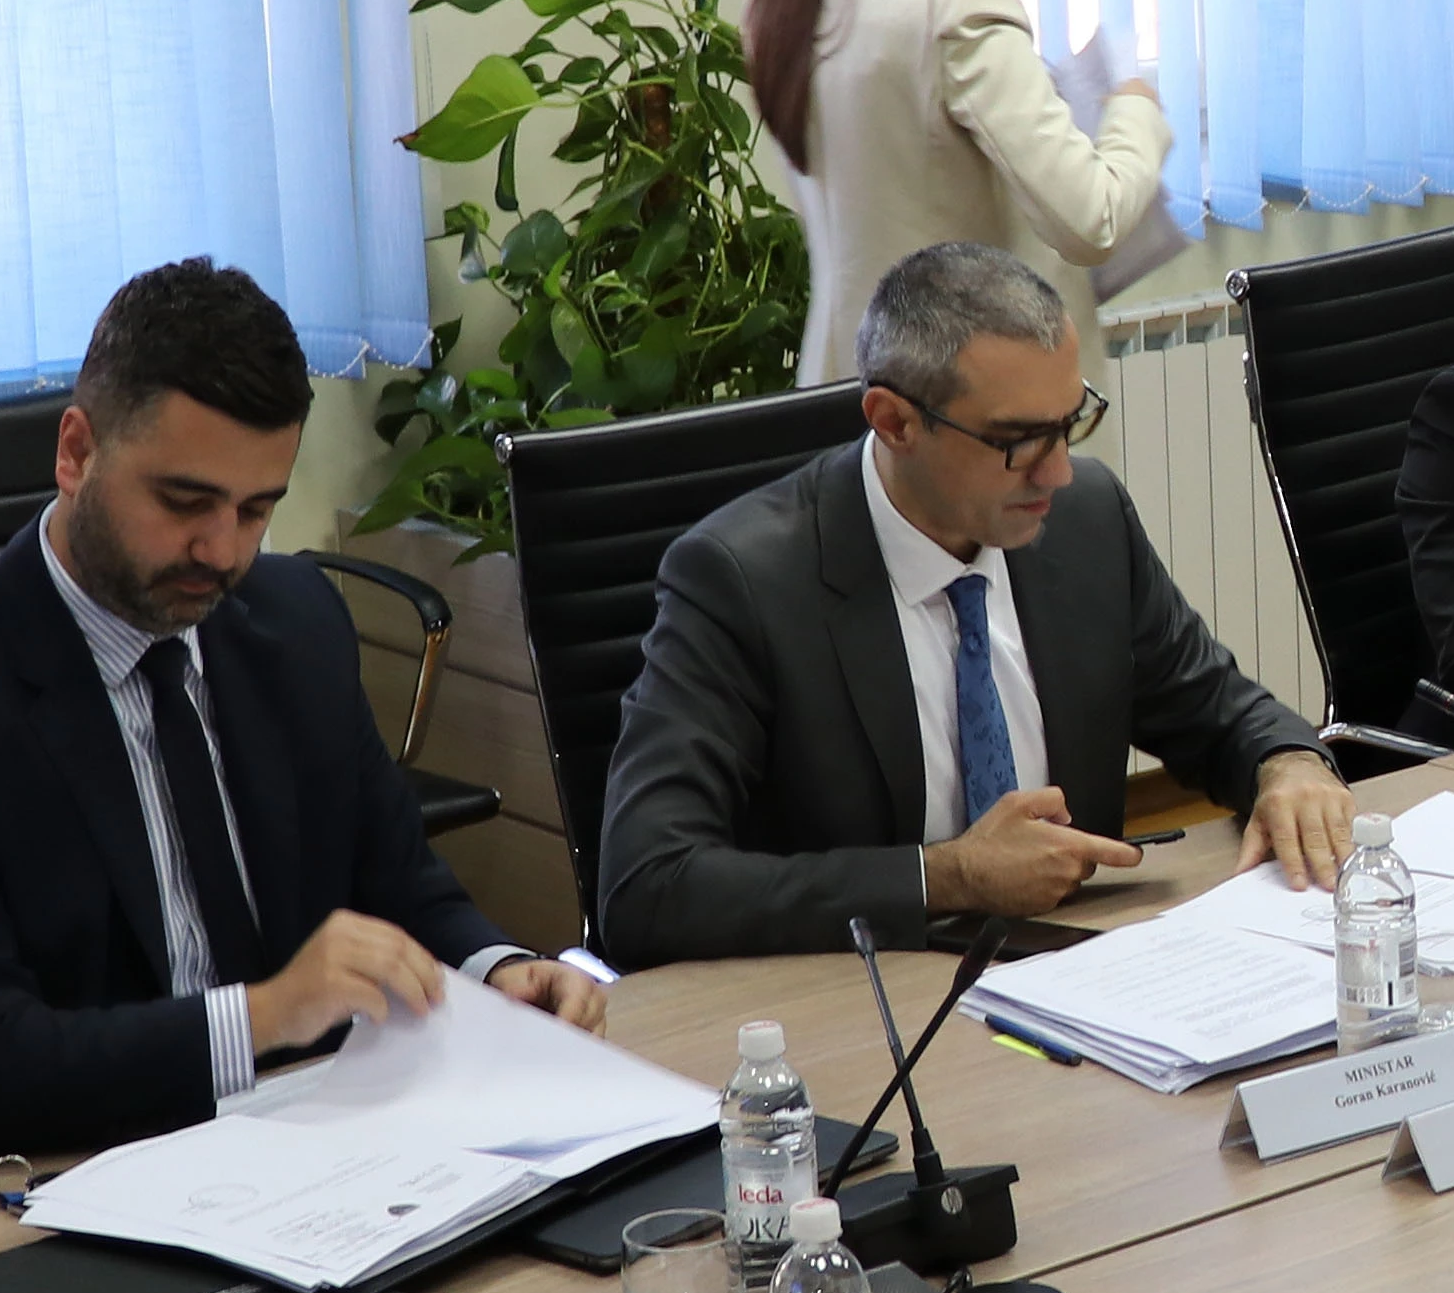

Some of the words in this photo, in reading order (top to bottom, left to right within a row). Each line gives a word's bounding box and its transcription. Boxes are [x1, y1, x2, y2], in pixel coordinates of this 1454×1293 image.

[1344, 1055, 1415, 1084] MINISTAR
[1334, 1090, 1374, 1109] Goran
[1375, 1071, 1437, 1098] Karanović
[738, 1184, 783, 1205] leda
